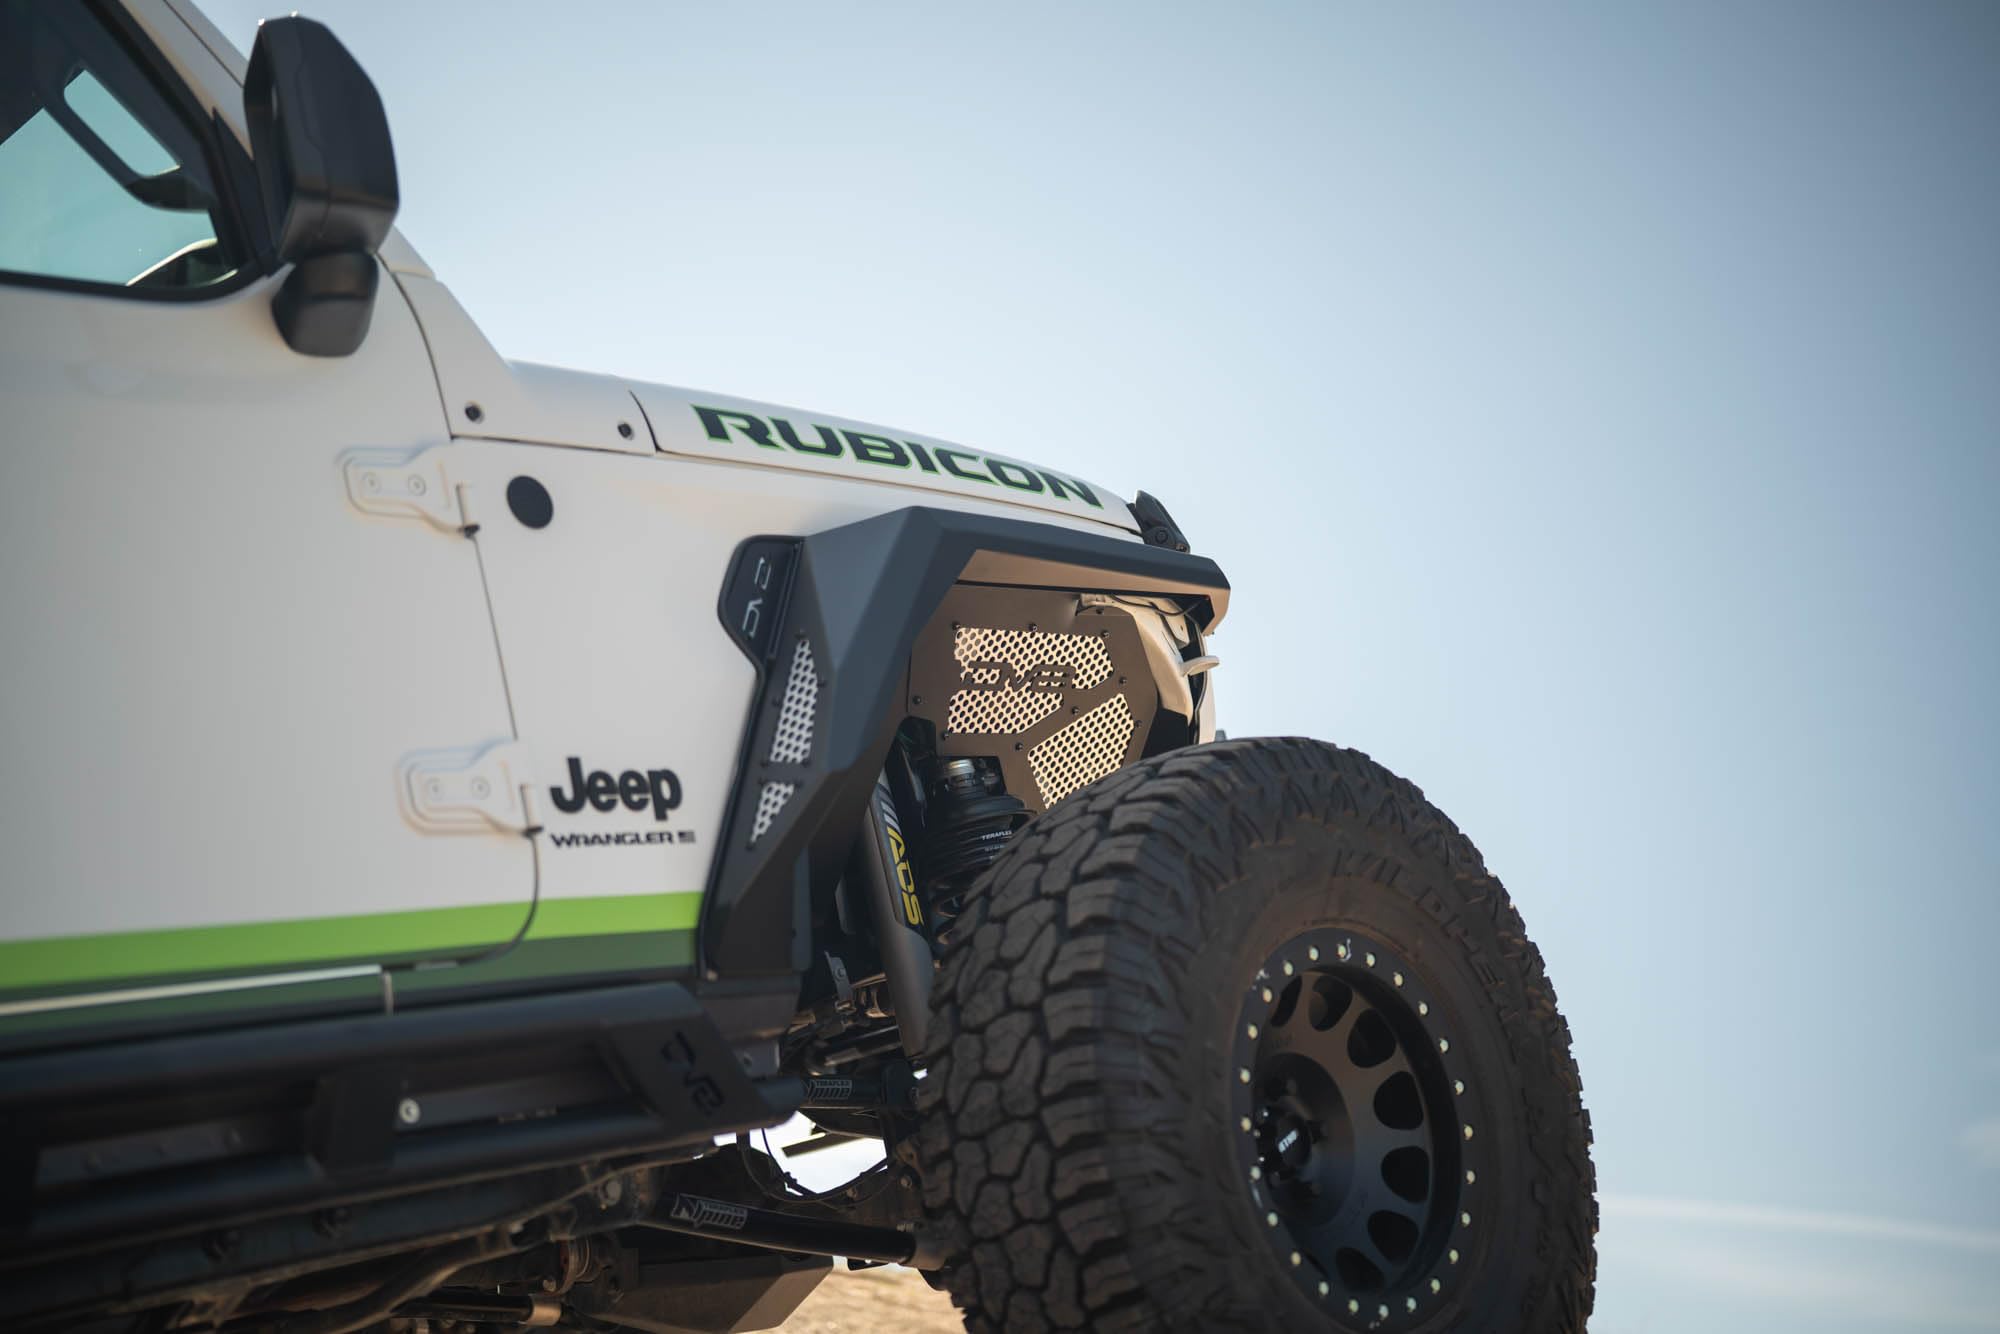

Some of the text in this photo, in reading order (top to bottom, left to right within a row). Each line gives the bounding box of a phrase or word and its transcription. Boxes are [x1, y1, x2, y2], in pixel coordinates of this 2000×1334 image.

[690, 404, 1104, 509] RUBICON
[549, 757, 683, 822] Jeep
[550, 831, 673, 847] WRANGLER
